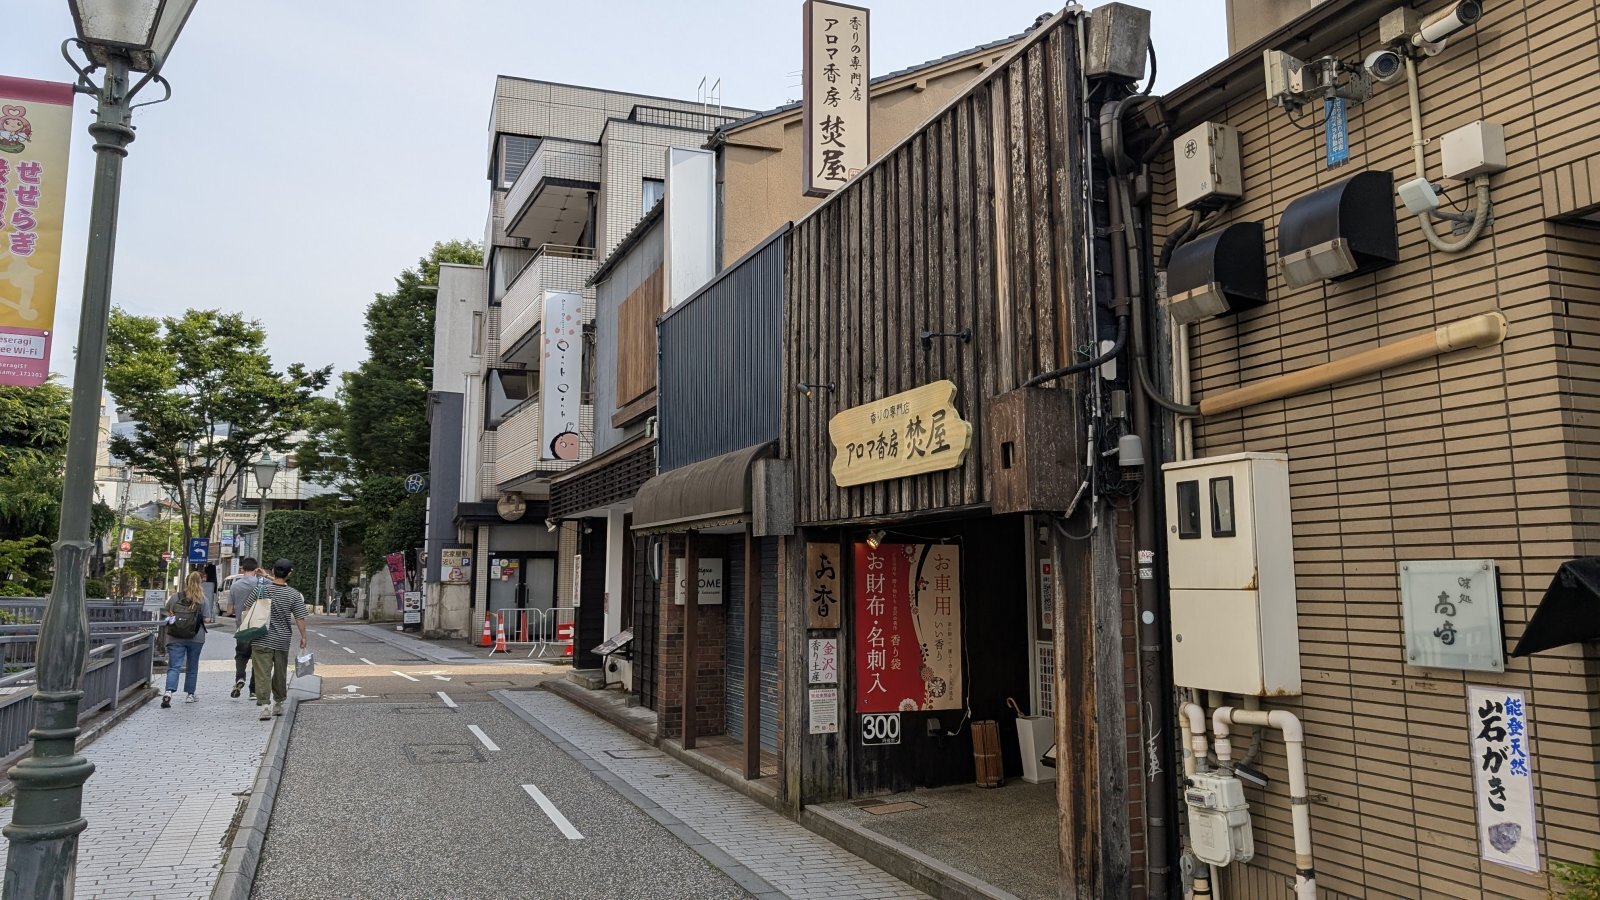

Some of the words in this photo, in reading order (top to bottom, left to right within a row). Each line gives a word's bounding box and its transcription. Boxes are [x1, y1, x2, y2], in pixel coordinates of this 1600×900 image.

[849, 16, 862, 101] 香りの専門店
[10, 161, 42, 256] せせらぎ
[14, 347, 38, 355] Wi-Fi
[870, 401, 910, 424] 香りの専門店
[813, 553, 837, 618] お香
[934, 553, 951, 616] お車用
[866, 552, 887, 694] お財布・名刺入
[890, 634, 902, 670] 香り袋
[811, 639, 821, 683] 香り土産
[822, 640, 837, 680] 金沢の
[863, 715, 899, 739] 300
[1475, 699, 1510, 812] 岩がき
[1504, 696, 1528, 777] 能登天然
